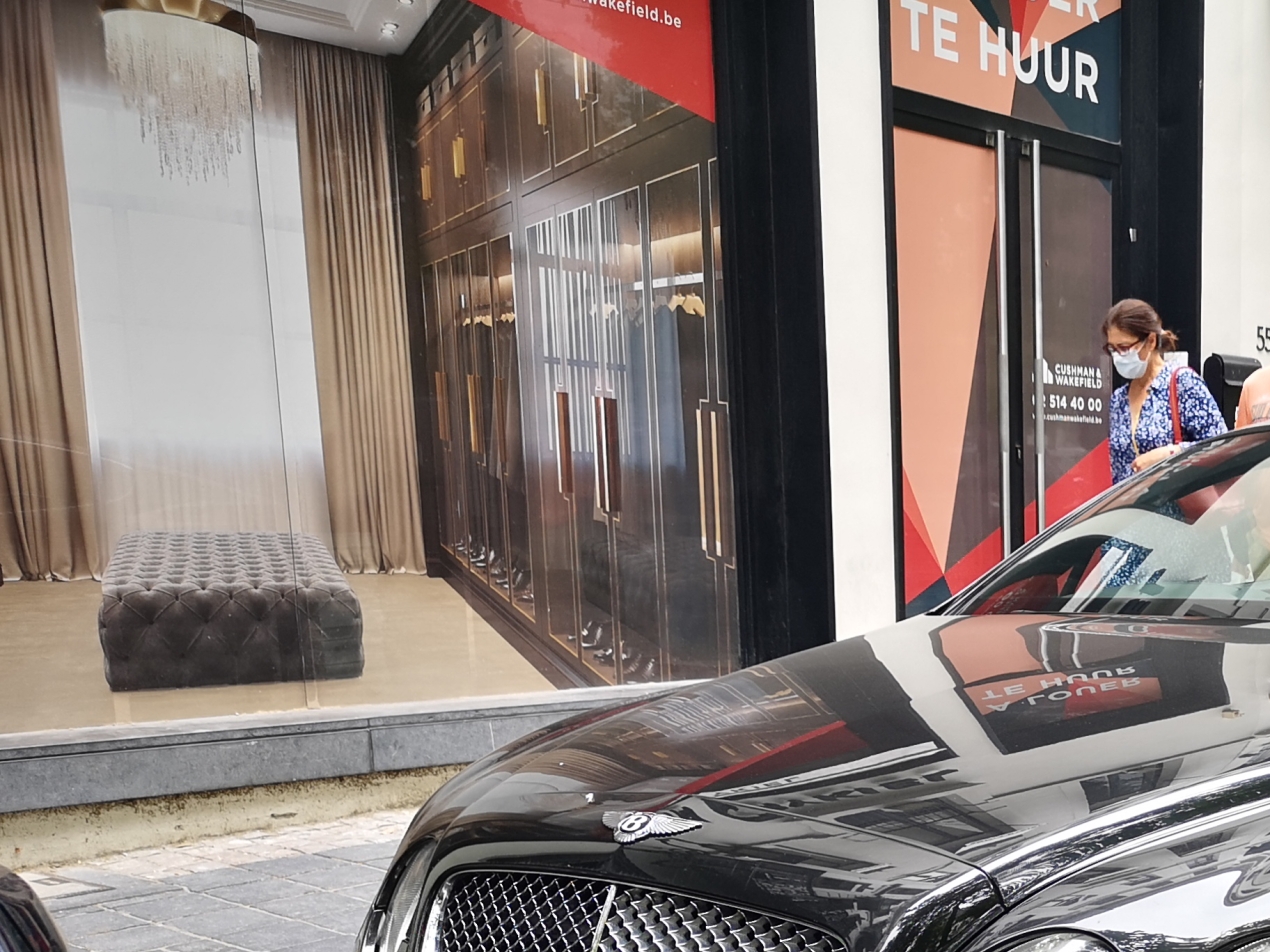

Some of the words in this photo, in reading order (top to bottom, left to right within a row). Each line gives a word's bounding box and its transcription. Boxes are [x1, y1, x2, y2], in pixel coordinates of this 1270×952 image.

[901, 0, 959, 63] TE
[979, 20, 1099, 104] HUUR
[1054, 363, 1094, 378] CUSHMAN
[1096, 367, 1102, 378] &
[1055, 374, 1103, 389] WAKEFIELD
[1049, 394, 1067, 410] 514
[1070, 396, 1085, 411] 40
[1088, 397, 1102, 412] 00
